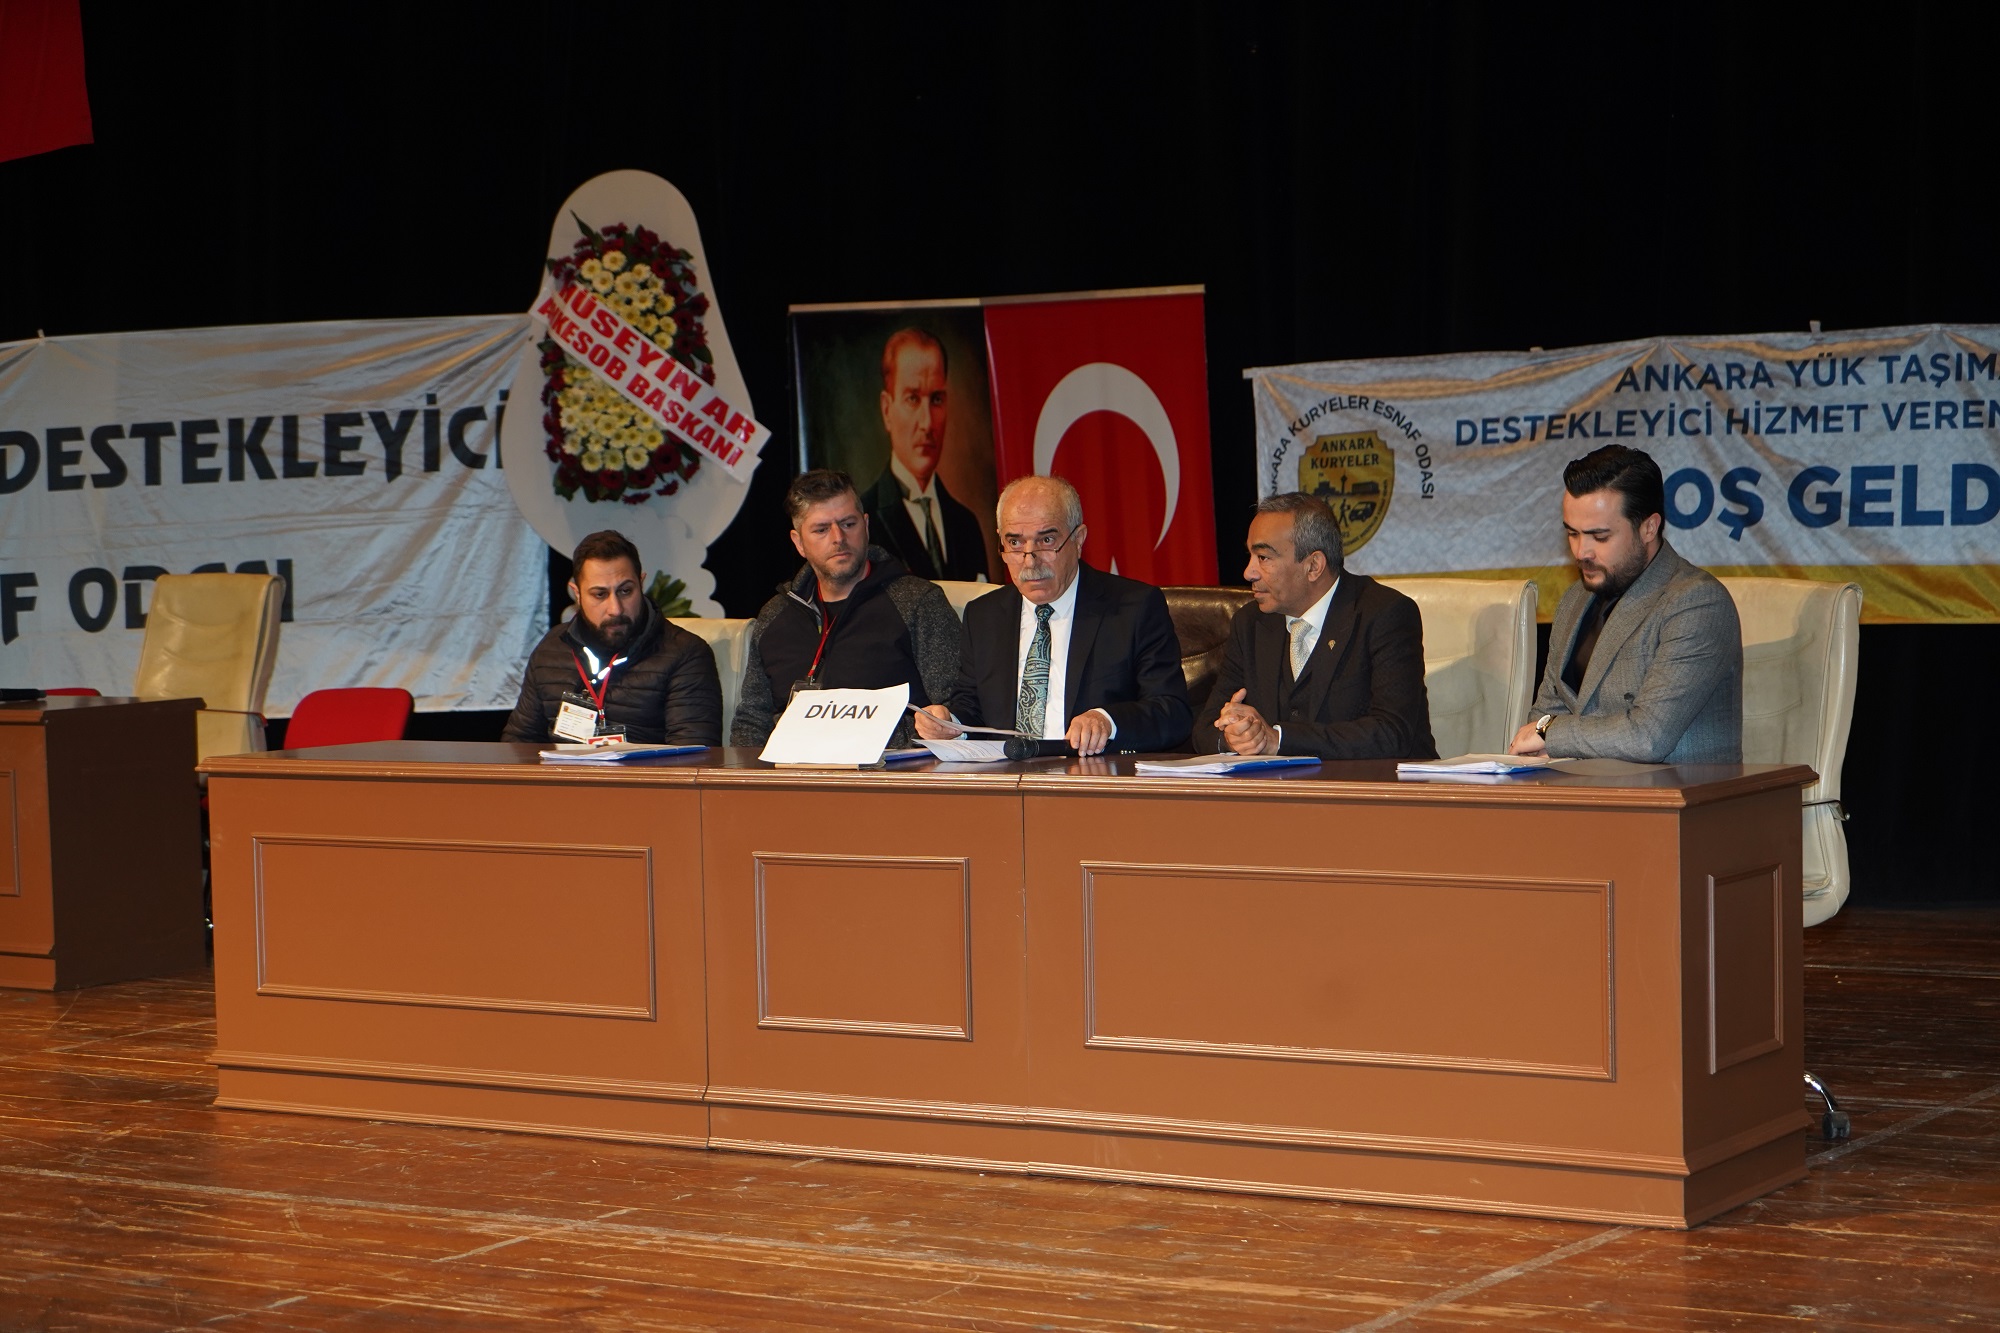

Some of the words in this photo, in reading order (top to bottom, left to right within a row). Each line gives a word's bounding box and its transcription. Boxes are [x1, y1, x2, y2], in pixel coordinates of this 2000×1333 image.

[537, 297, 628, 381] AKESOB
[1614, 360, 1775, 393] ANKARA
[1786, 352, 1866, 388] YÜK
[1878, 352, 2000, 389] TAŞIM
[701, 396, 756, 444] AR
[1456, 401, 1712, 446] DESTEKLEYİCİ
[1726, 400, 1869, 436] HİZMET
[1271, 437, 1291, 497] NKARA
[1288, 395, 1370, 437] KURYELER
[1373, 400, 1422, 442] ESNAF
[1415, 443, 1434, 500] ODASI
[1311, 453, 1380, 470] KURYELER
[1321, 437, 1375, 453] ANKARA
[1664, 465, 1765, 542] OŞ
[68, 558, 295, 633] ODI
[804, 700, 879, 720] DİVAN
